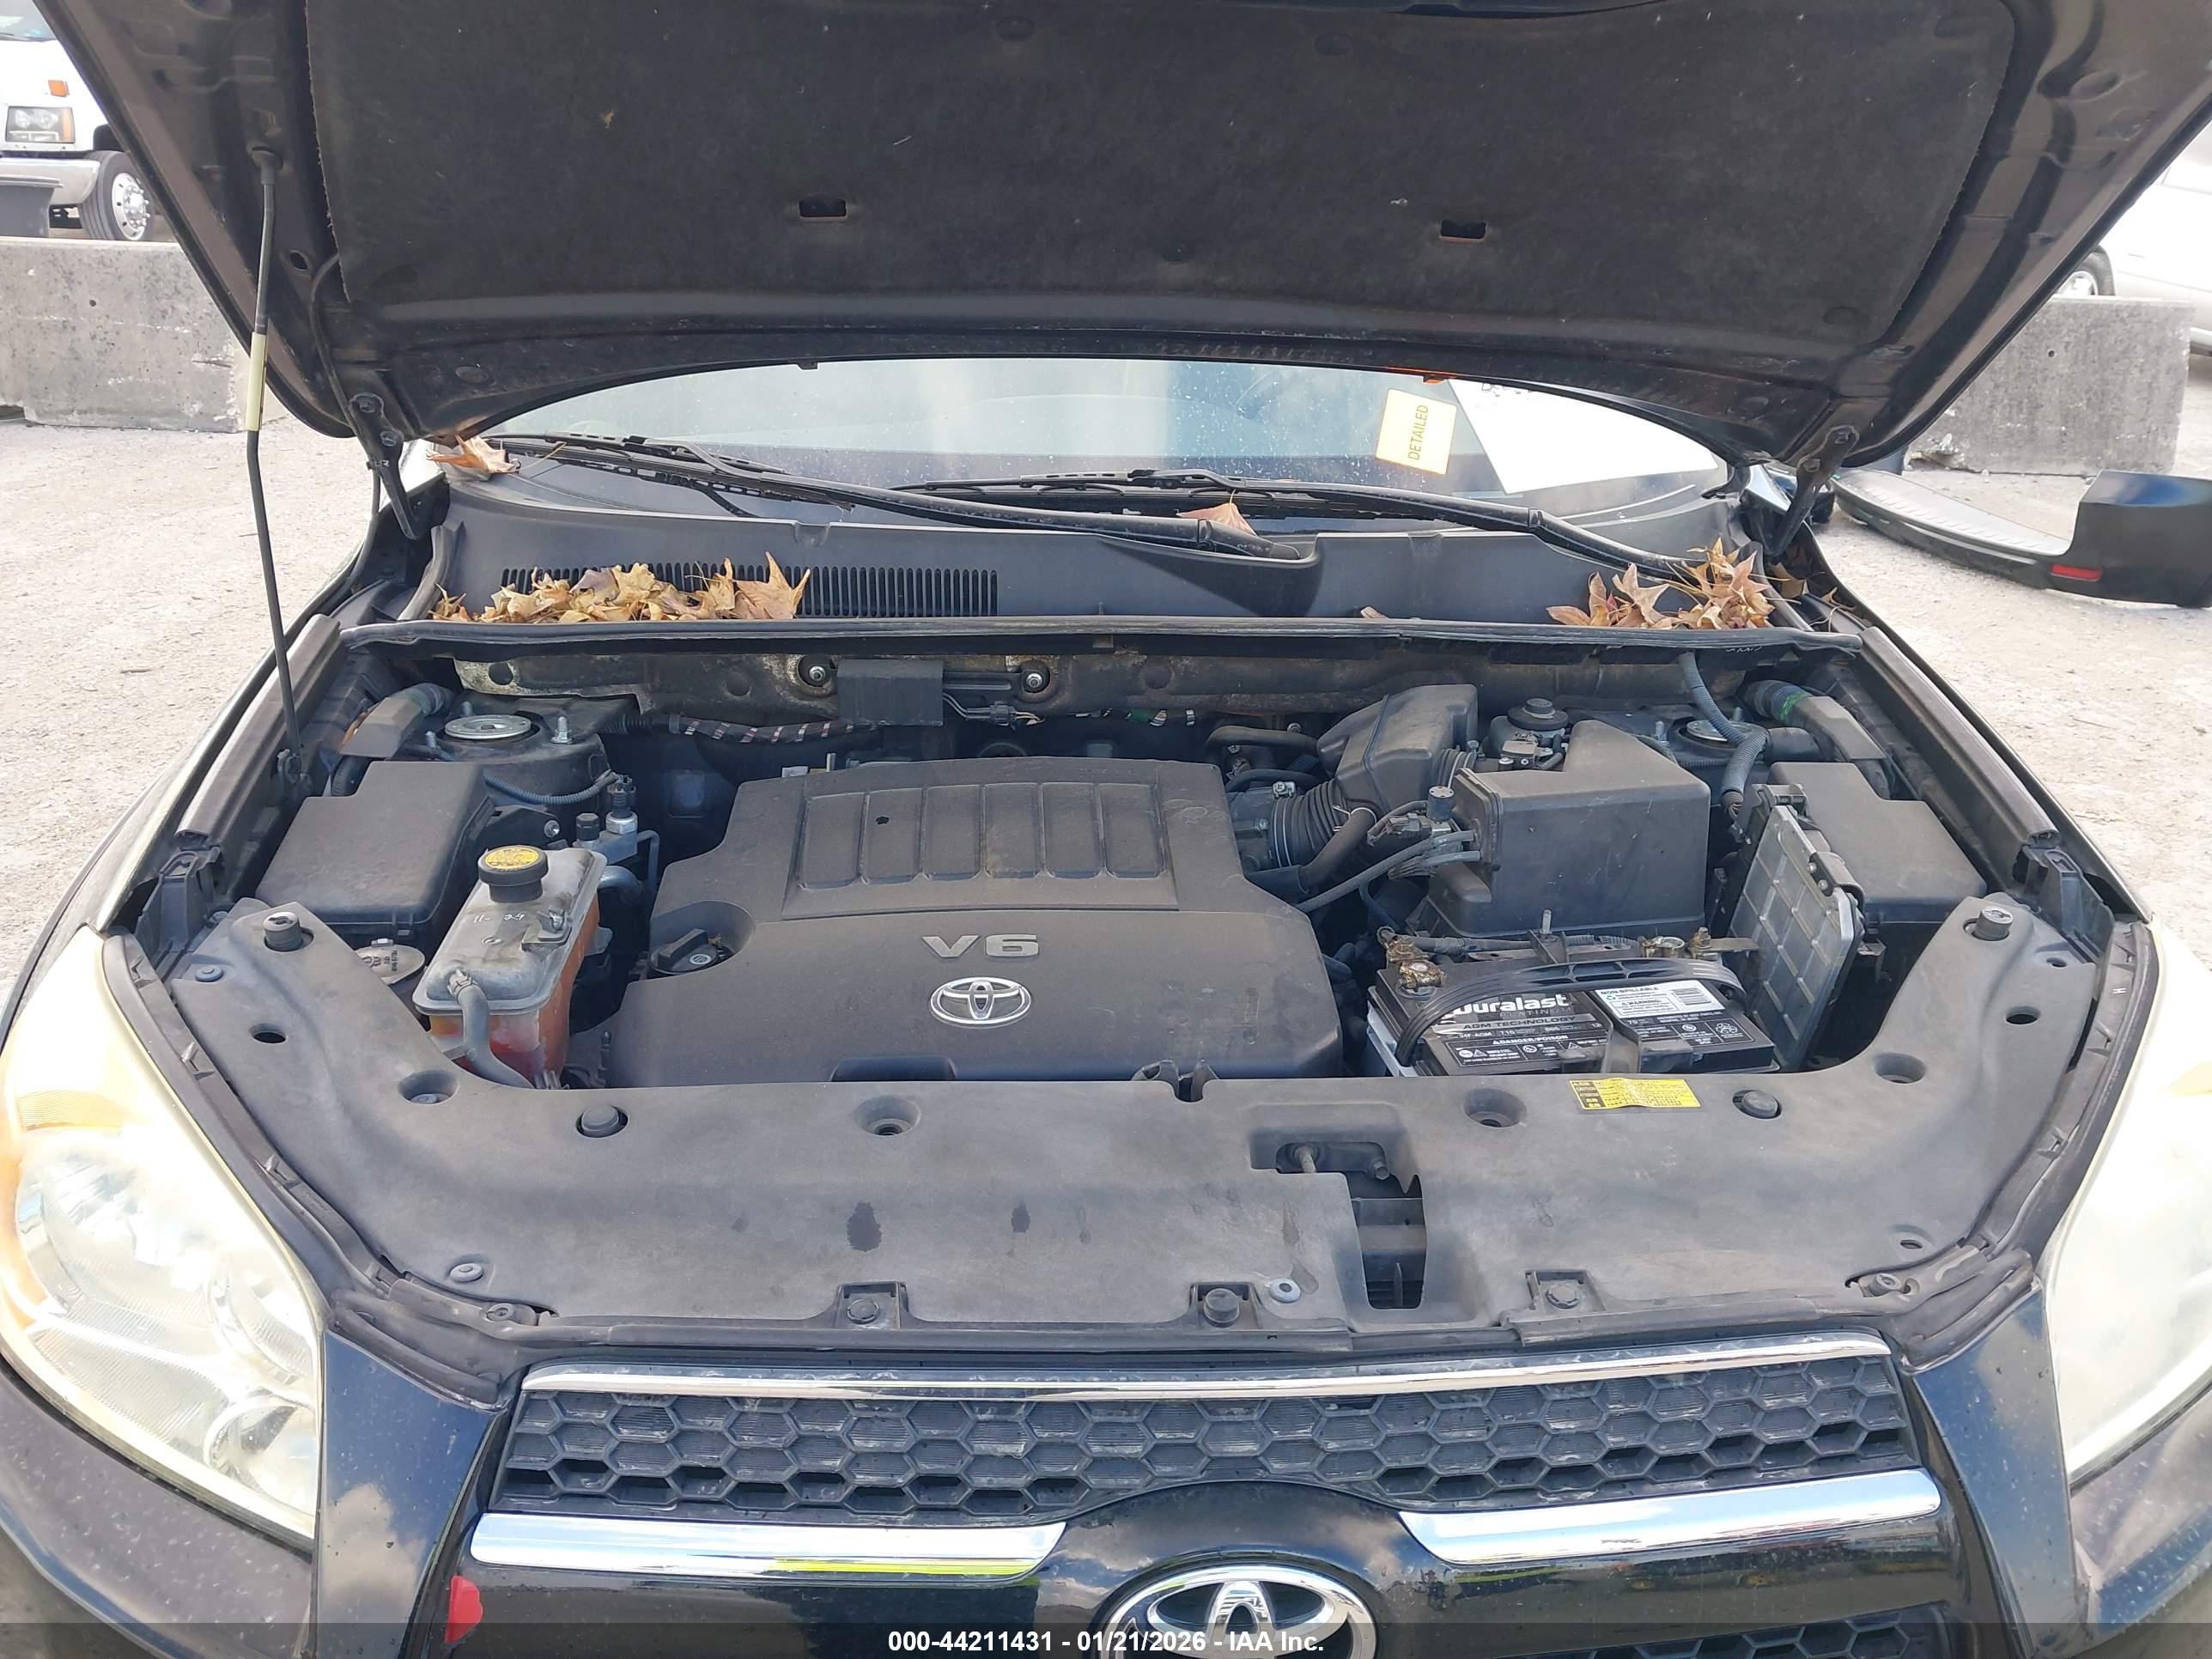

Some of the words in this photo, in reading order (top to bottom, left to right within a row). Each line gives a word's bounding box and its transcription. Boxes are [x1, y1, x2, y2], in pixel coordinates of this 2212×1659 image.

[1408, 404, 1429, 460] DETAILED
[921, 934, 1040, 957] V6
[1499, 1006, 1573, 1018] PLATINUM
[1497, 1017, 1576, 1027] TECHNOLOGY
